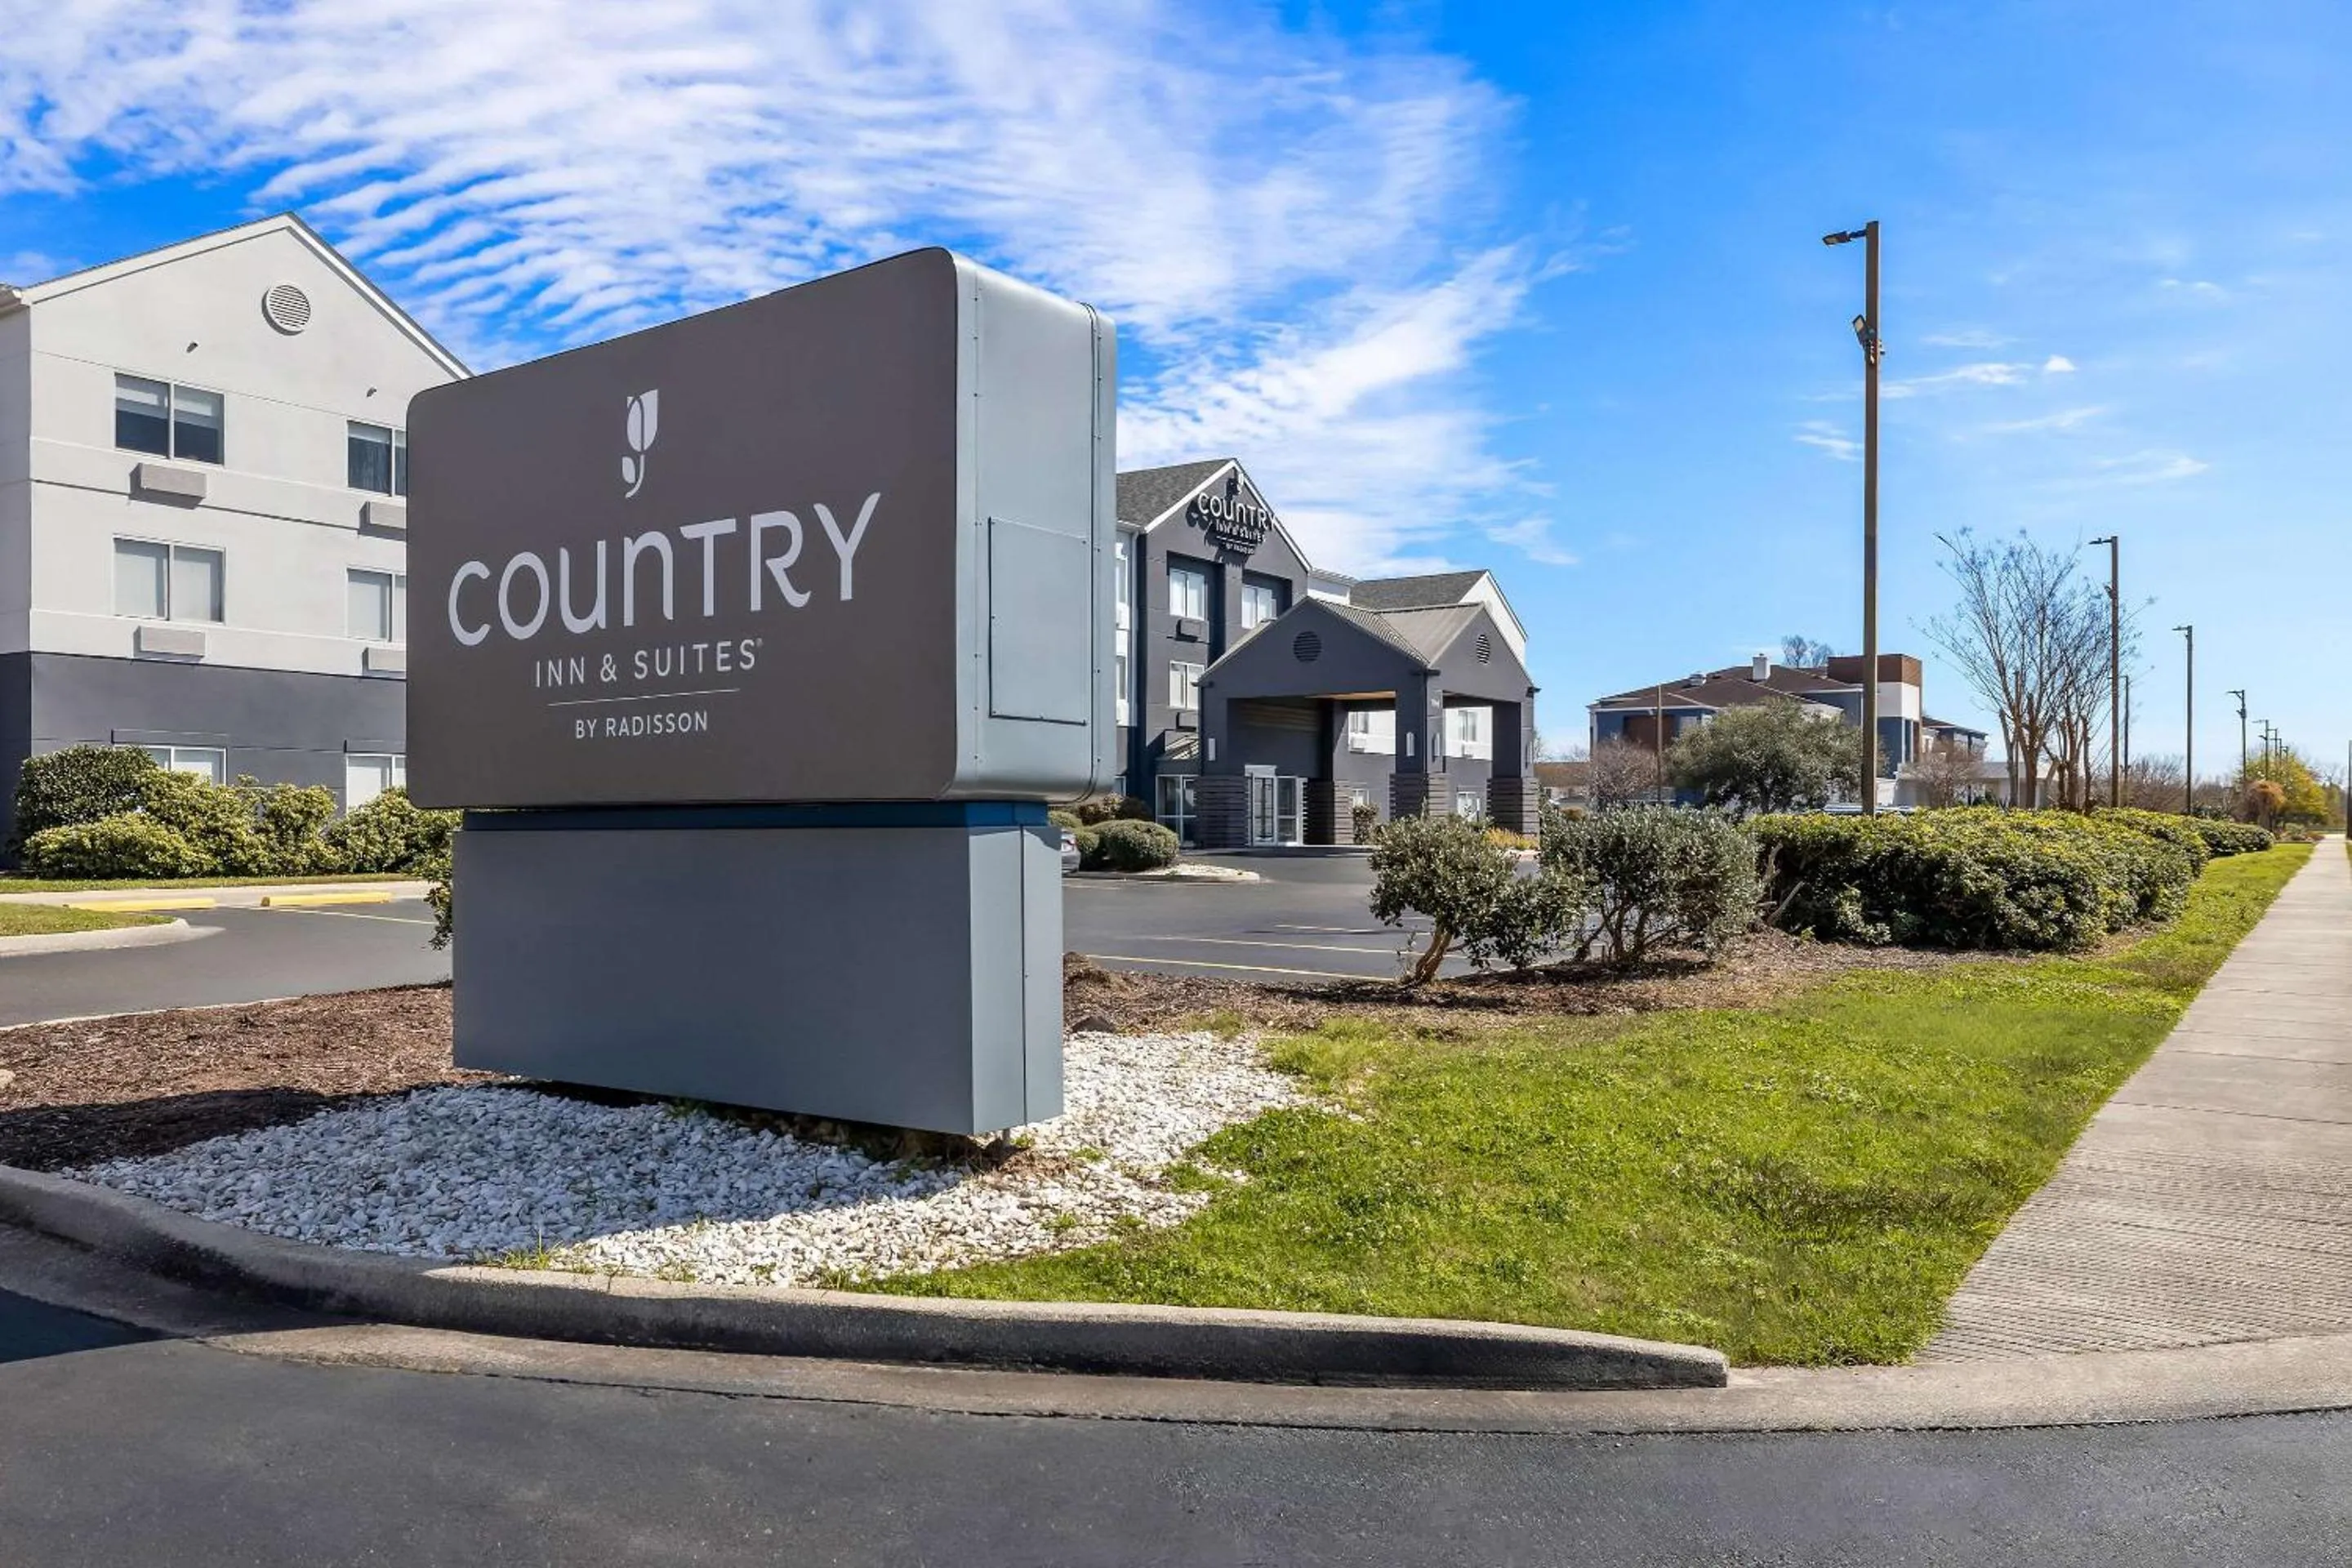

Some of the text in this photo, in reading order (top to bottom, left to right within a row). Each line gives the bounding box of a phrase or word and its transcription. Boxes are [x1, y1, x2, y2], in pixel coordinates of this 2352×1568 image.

[448, 492, 881, 646] COUNTRY
[537, 656, 585, 688] INN
[599, 653, 617, 683] &
[576, 710, 708, 739] BY RADISSON
